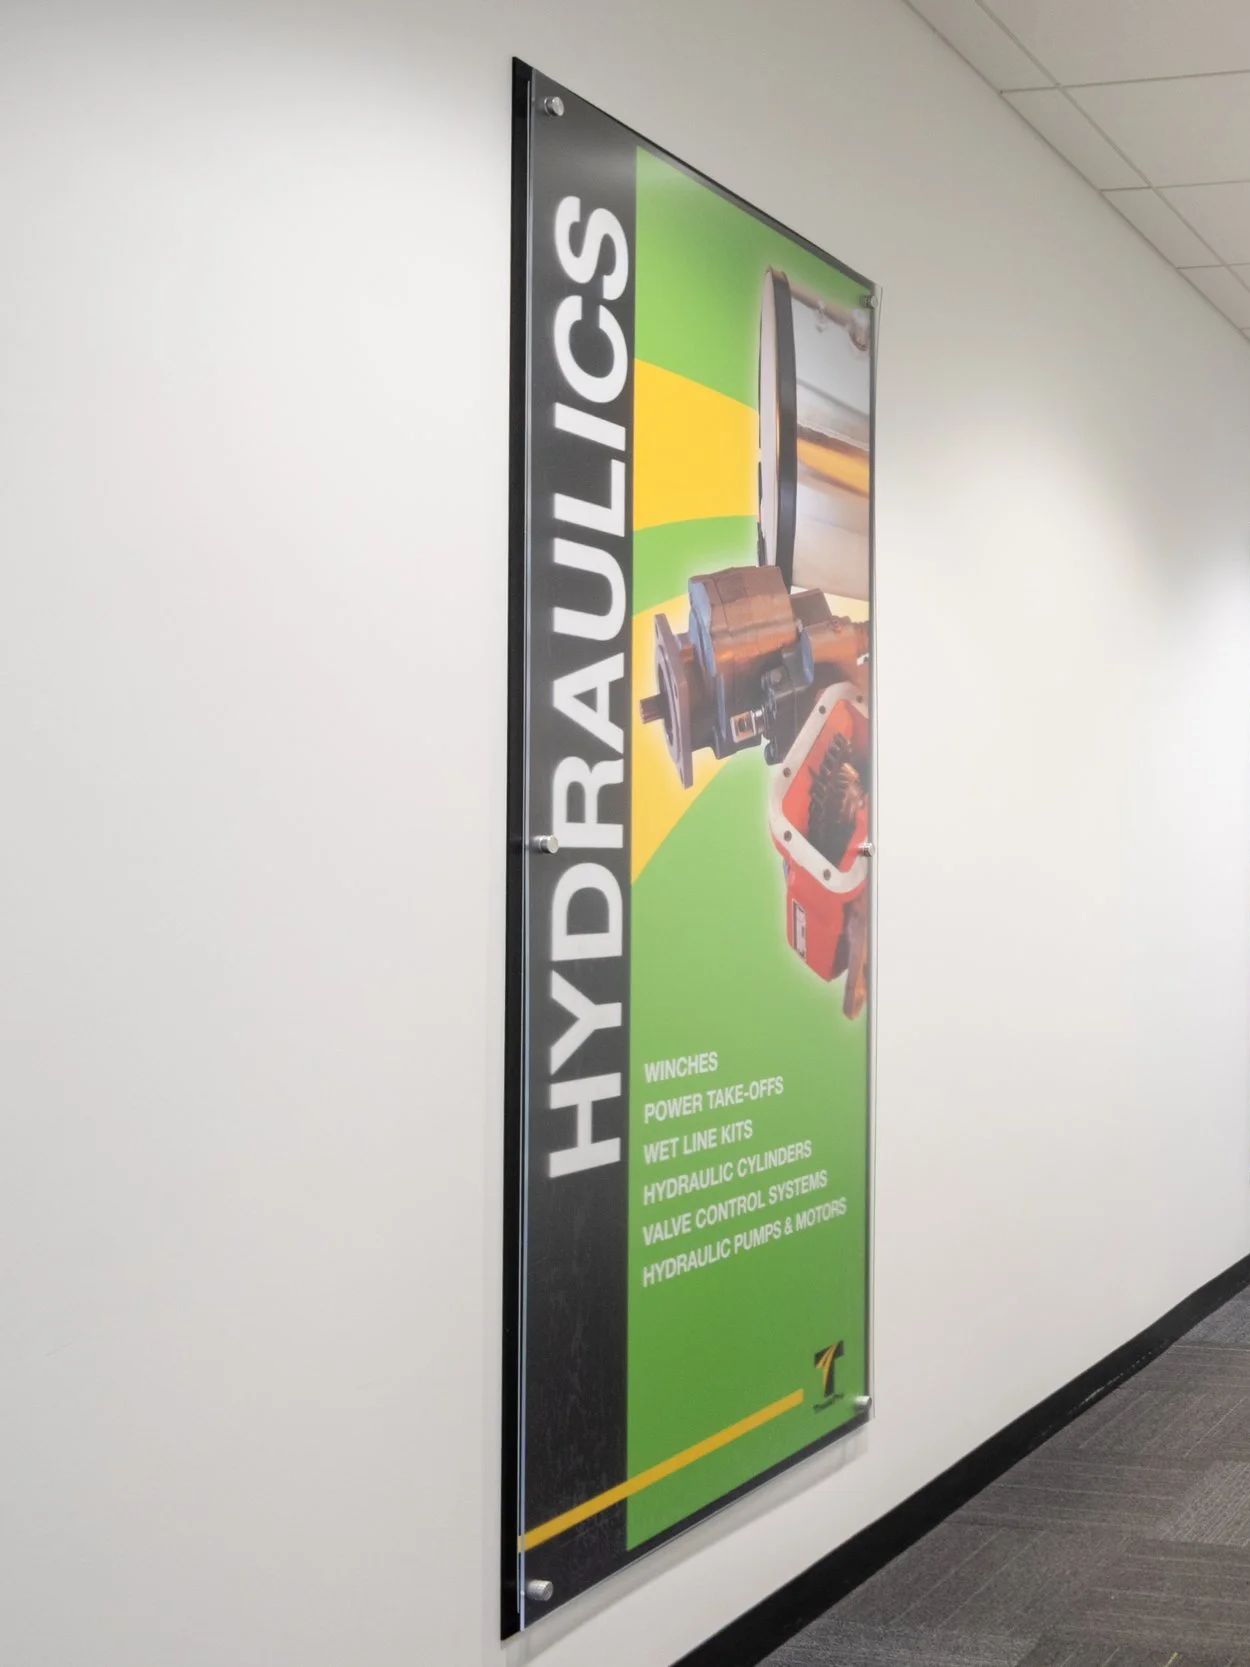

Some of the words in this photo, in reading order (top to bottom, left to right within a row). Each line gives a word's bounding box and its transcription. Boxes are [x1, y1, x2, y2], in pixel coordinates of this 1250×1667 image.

[549, 195, 629, 1178] HYDRAULICS
[644, 1051, 718, 1083] WINCHES
[644, 1093, 703, 1124] POWER
[706, 1076, 784, 1109] TAKE-OFFS
[644, 1137, 679, 1165] WET
[683, 1128, 717, 1155] LINE
[721, 1119, 753, 1144] KITS
[644, 1162, 734, 1206] HYDRAULIC
[737, 1140, 812, 1178] CYLINDERS
[643, 1213, 692, 1246] VALVE
[695, 1190, 766, 1229] CONTROL
[769, 1170, 828, 1205] SYSTEMS
[643, 1238, 731, 1287] HYDRAULIC
[734, 1220, 782, 1254] PUMPS
[784, 1216, 793, 1234] &
[796, 1197, 848, 1232] MOTORS
